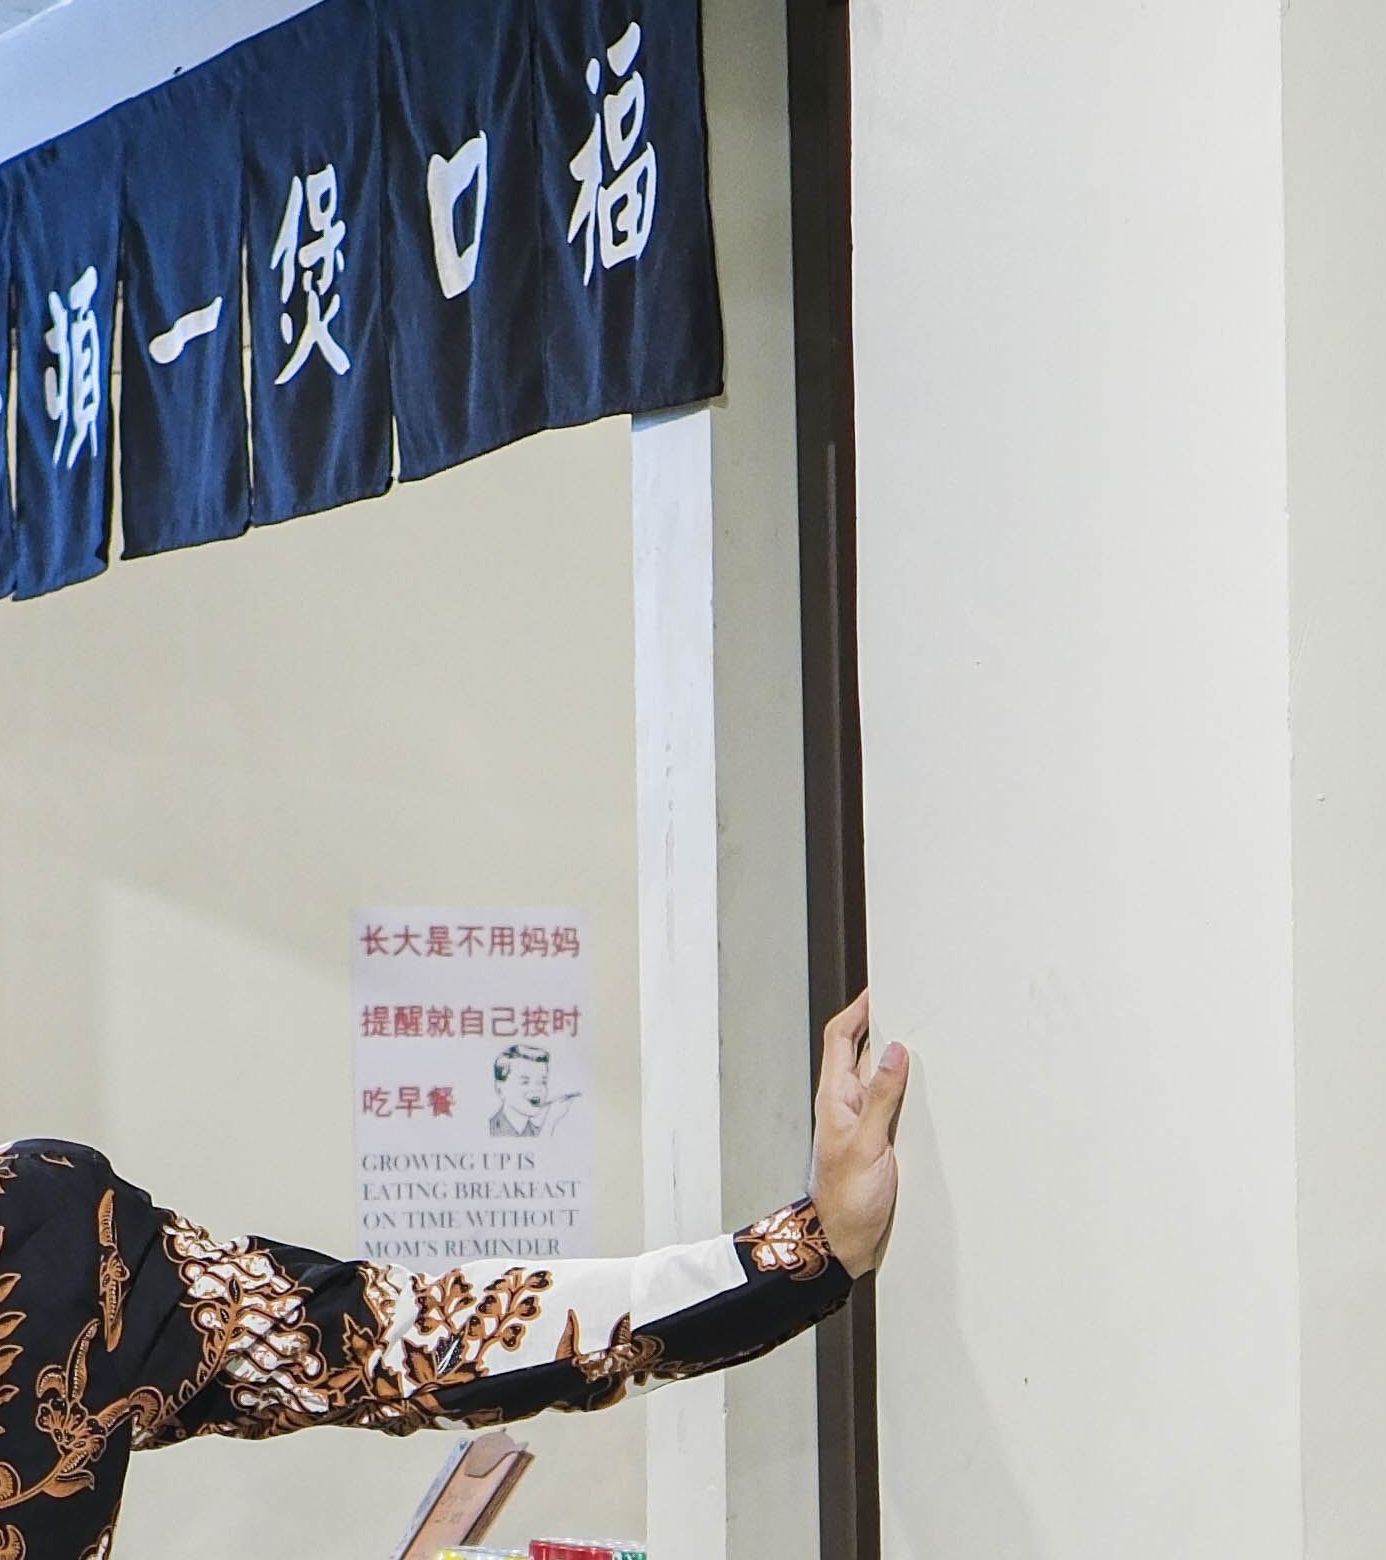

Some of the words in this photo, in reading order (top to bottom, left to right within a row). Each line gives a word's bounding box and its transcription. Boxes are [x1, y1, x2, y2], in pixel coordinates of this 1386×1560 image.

[360, 925, 580, 958] 长大是不用妈妈
[360, 1005, 581, 1039] 提醒就自己按时
[362, 1086, 457, 1119] 吃早餐
[362, 1152, 475, 1171] GROWING
[482, 1153, 512, 1171] UP
[517, 1152, 536, 1170] IS
[362, 1182, 448, 1201] EATING
[454, 1180, 582, 1200] BREAKFAST
[363, 1211, 397, 1229] ON
[402, 1210, 459, 1229] TIME
[465, 1209, 580, 1228] WITHOUT
[364, 1239, 439, 1258] MOM'S
[444, 1237, 562, 1257] REMINDER
